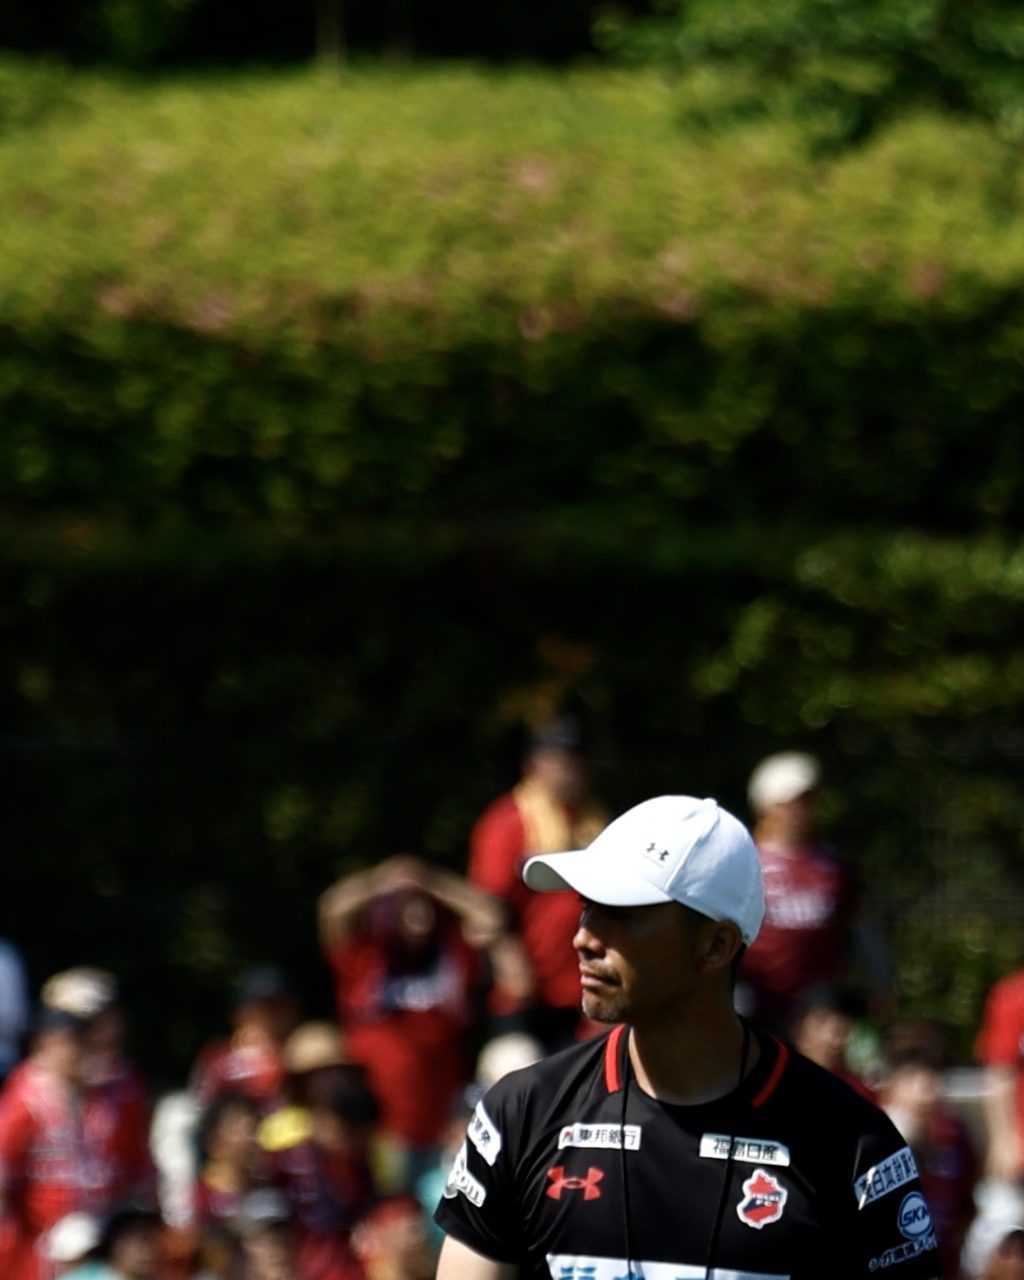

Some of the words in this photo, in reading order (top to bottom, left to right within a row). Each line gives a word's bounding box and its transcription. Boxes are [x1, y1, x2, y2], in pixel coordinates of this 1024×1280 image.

[577, 1128, 637, 1146] 東邦銀行
[713, 1138, 778, 1161] 福島日産
